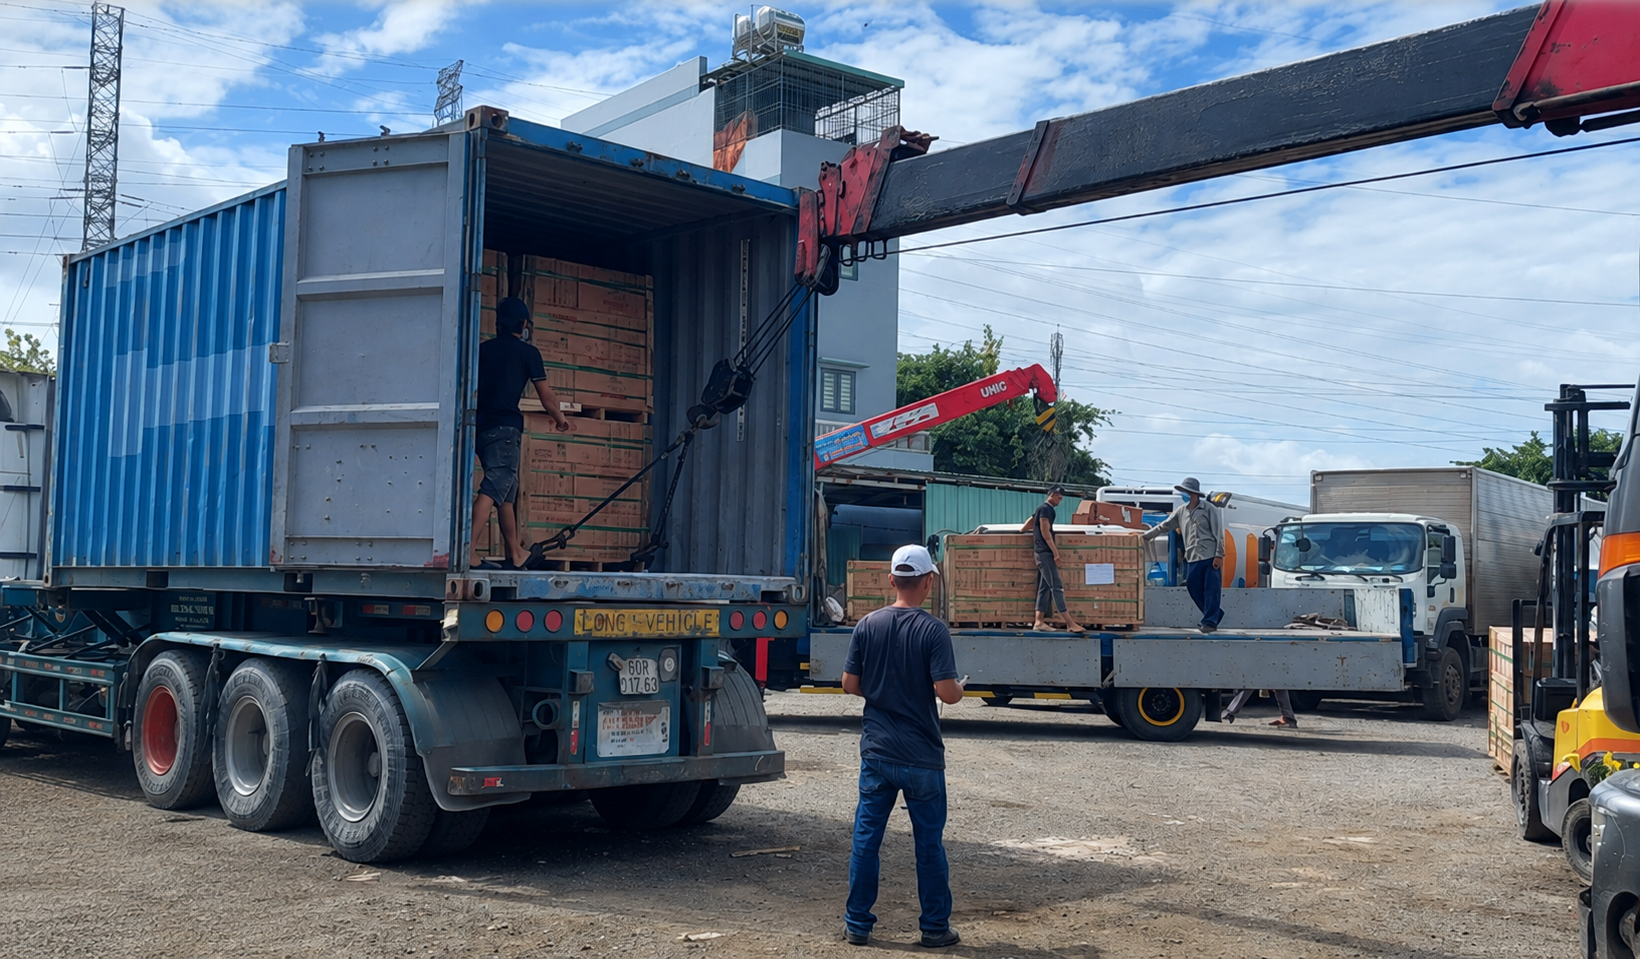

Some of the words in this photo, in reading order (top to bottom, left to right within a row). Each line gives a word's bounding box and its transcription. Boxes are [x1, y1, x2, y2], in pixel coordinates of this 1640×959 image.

[582, 612, 625, 632] LONG
[645, 612, 713, 632] VEHICLE
[629, 660, 649, 675] 60R
